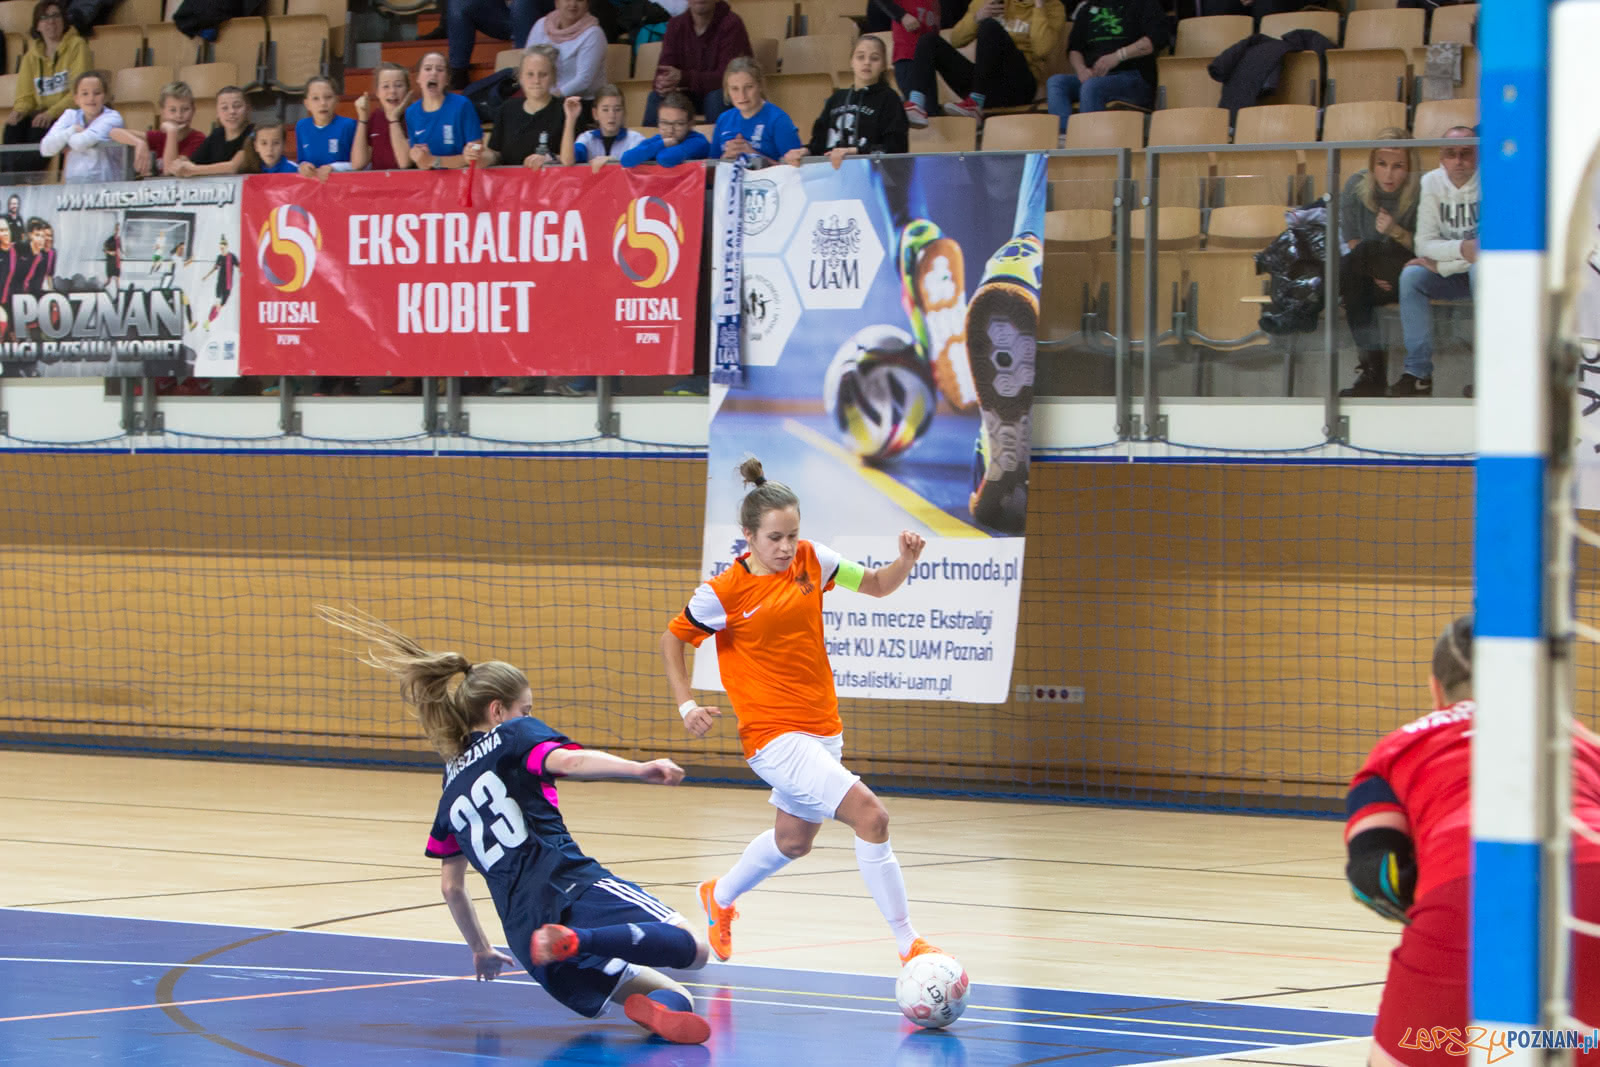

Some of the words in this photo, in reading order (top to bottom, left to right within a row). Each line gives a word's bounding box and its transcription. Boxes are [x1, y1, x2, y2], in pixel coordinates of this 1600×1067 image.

[349, 210, 588, 265] EKSTRALIGA
[809, 259, 860, 290] UAM
[258, 300, 320, 323] FUTSAL
[398, 281, 536, 334] KOBIET
[615, 297, 682, 321] FUTSAL
[822, 610, 843, 631] my
[848, 611, 867, 627] na
[872, 611, 925, 629] mecze
[930, 609, 993, 636] Ekstraligi
[824, 636, 850, 656] biet
[855, 638, 874, 657] KU
[878, 639, 905, 659] AZS
[909, 640, 942, 661] UAM
[945, 641, 993, 662] Poznań
[450, 770, 528, 873] 23
